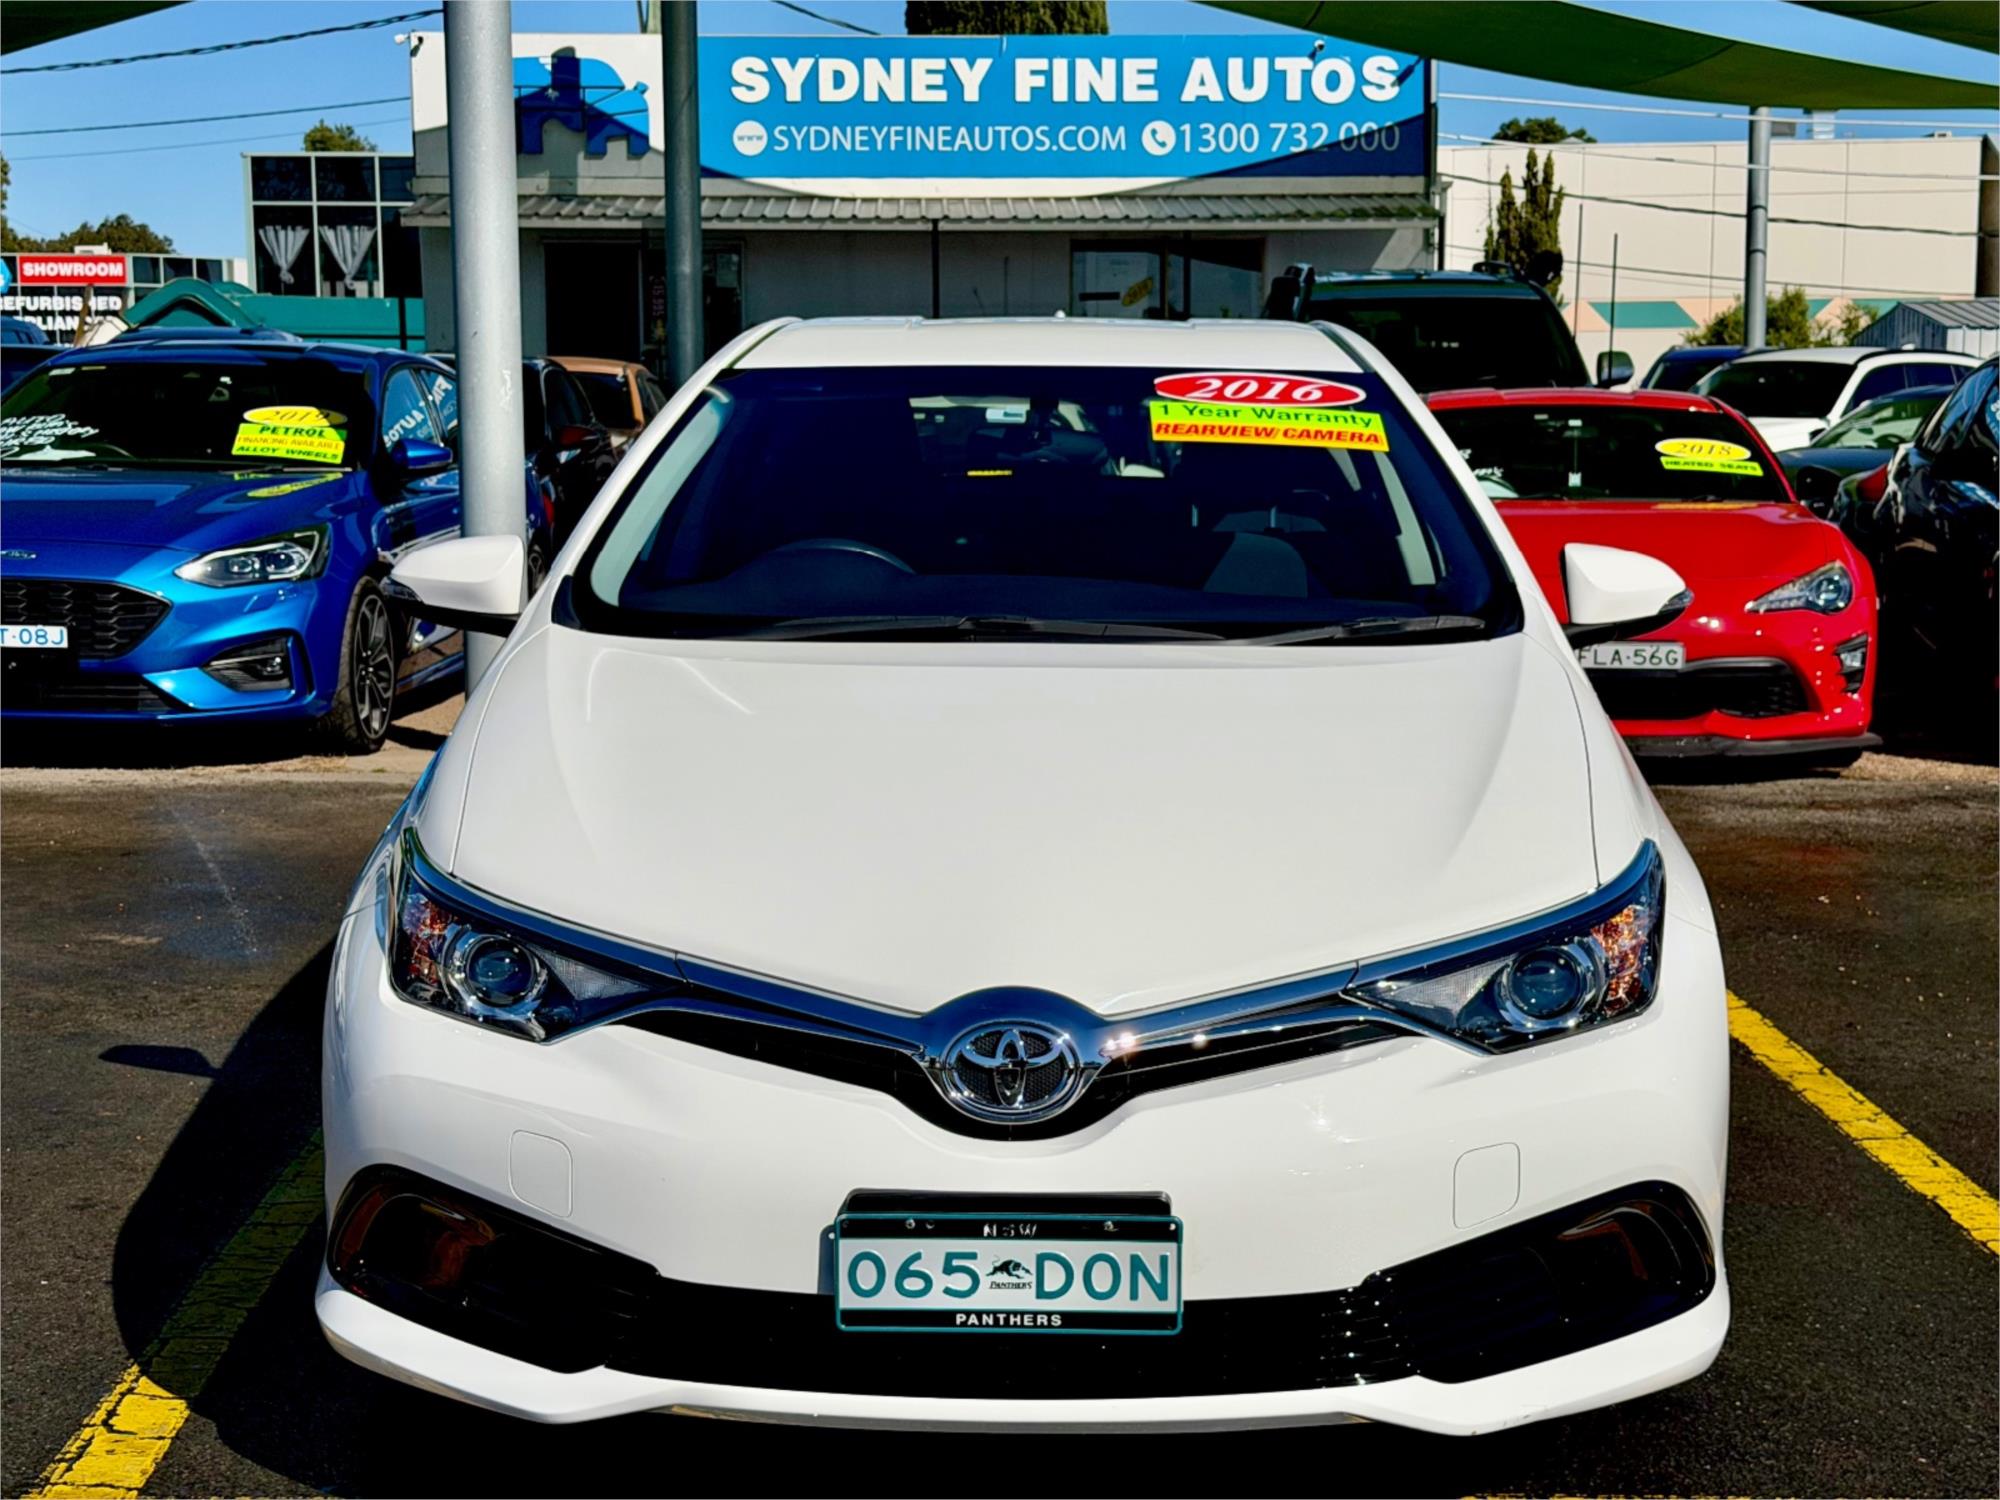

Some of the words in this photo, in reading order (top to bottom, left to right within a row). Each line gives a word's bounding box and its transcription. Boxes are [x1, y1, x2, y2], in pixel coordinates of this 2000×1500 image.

[731, 56, 994, 104] SYDNEY
[1014, 57, 1159, 103] FINE
[1180, 55, 1400, 104] AUTOS
[773, 125, 1126, 152] SYDNEYFINEAUTOS.COM
[1179, 122, 1260, 153] 1300
[1269, 122, 1329, 152] 732
[1340, 121, 1400, 151] 000
[23, 262, 123, 276] SHOWROOM
[0, 295, 122, 311] EFURBISED
[1185, 378, 1330, 402] 2016
[1159, 404, 1170, 415] 1
[1183, 404, 1242, 418] Year
[1251, 407, 1373, 428] Warranty
[259, 425, 327, 439] PETROL
[1155, 422, 1279, 438] REARVIEW
[1283, 427, 1381, 444] CAMERA
[236, 445, 280, 454] ALLOY
[285, 448, 339, 461] WHEELS
[1674, 443, 1732, 456] 2018
[847, 1251, 981, 1299] 065
[1035, 1252, 1170, 1301] DON
[955, 1313, 1063, 1327] PANTHERS
